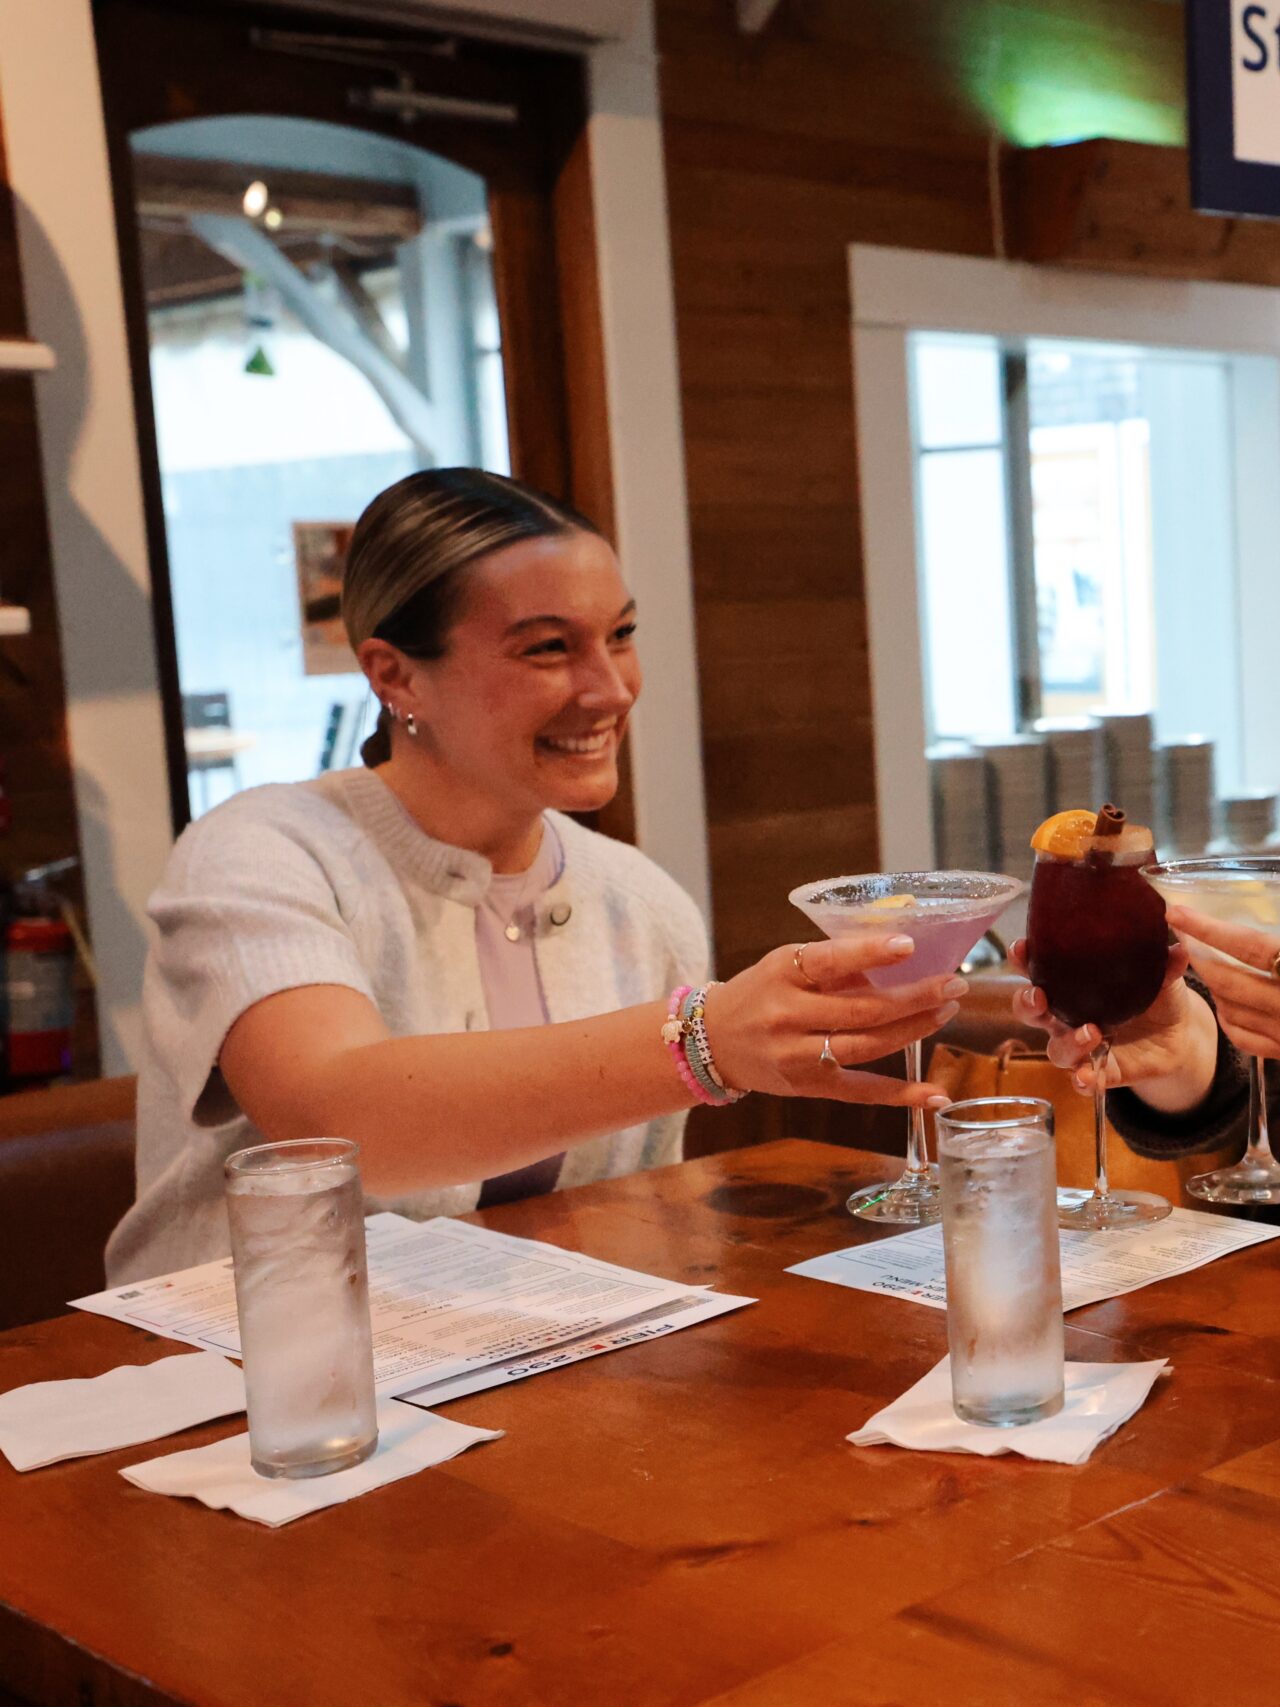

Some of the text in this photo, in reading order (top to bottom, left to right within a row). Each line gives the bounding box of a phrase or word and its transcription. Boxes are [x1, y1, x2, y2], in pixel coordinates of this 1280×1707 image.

[872, 1282, 907, 1292] 290
[880, 1275, 924, 1287] MENU
[527, 1317, 600, 1343] DINNER
[559, 1321, 603, 1338] PIER
[466, 1342, 524, 1361] MENU
[489, 1344, 529, 1360] 290
[507, 1324, 675, 1376] PIER 290
